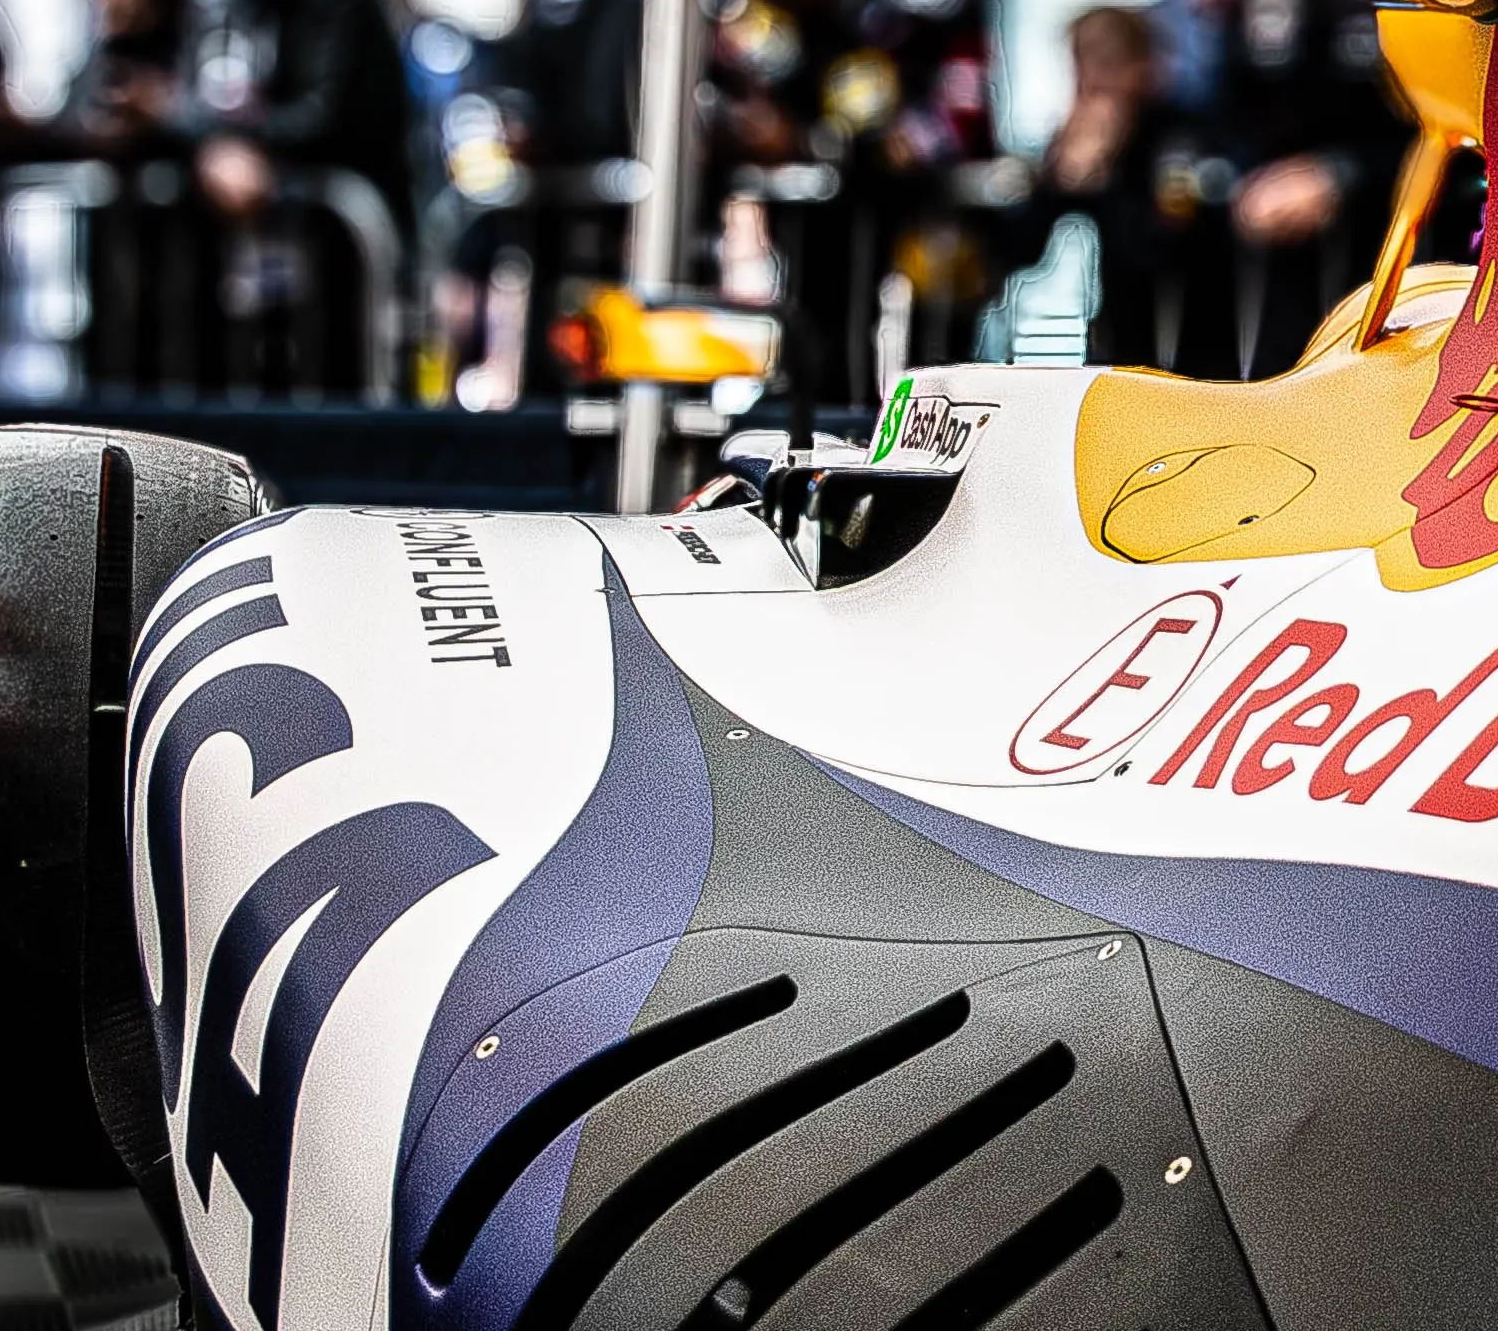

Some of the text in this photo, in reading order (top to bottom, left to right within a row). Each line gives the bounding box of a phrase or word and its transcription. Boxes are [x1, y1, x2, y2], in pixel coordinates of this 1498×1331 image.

[900, 398, 973, 466] Cash App
[395, 521, 513, 667] CONFLUENT
[1040, 617, 1198, 750] E
